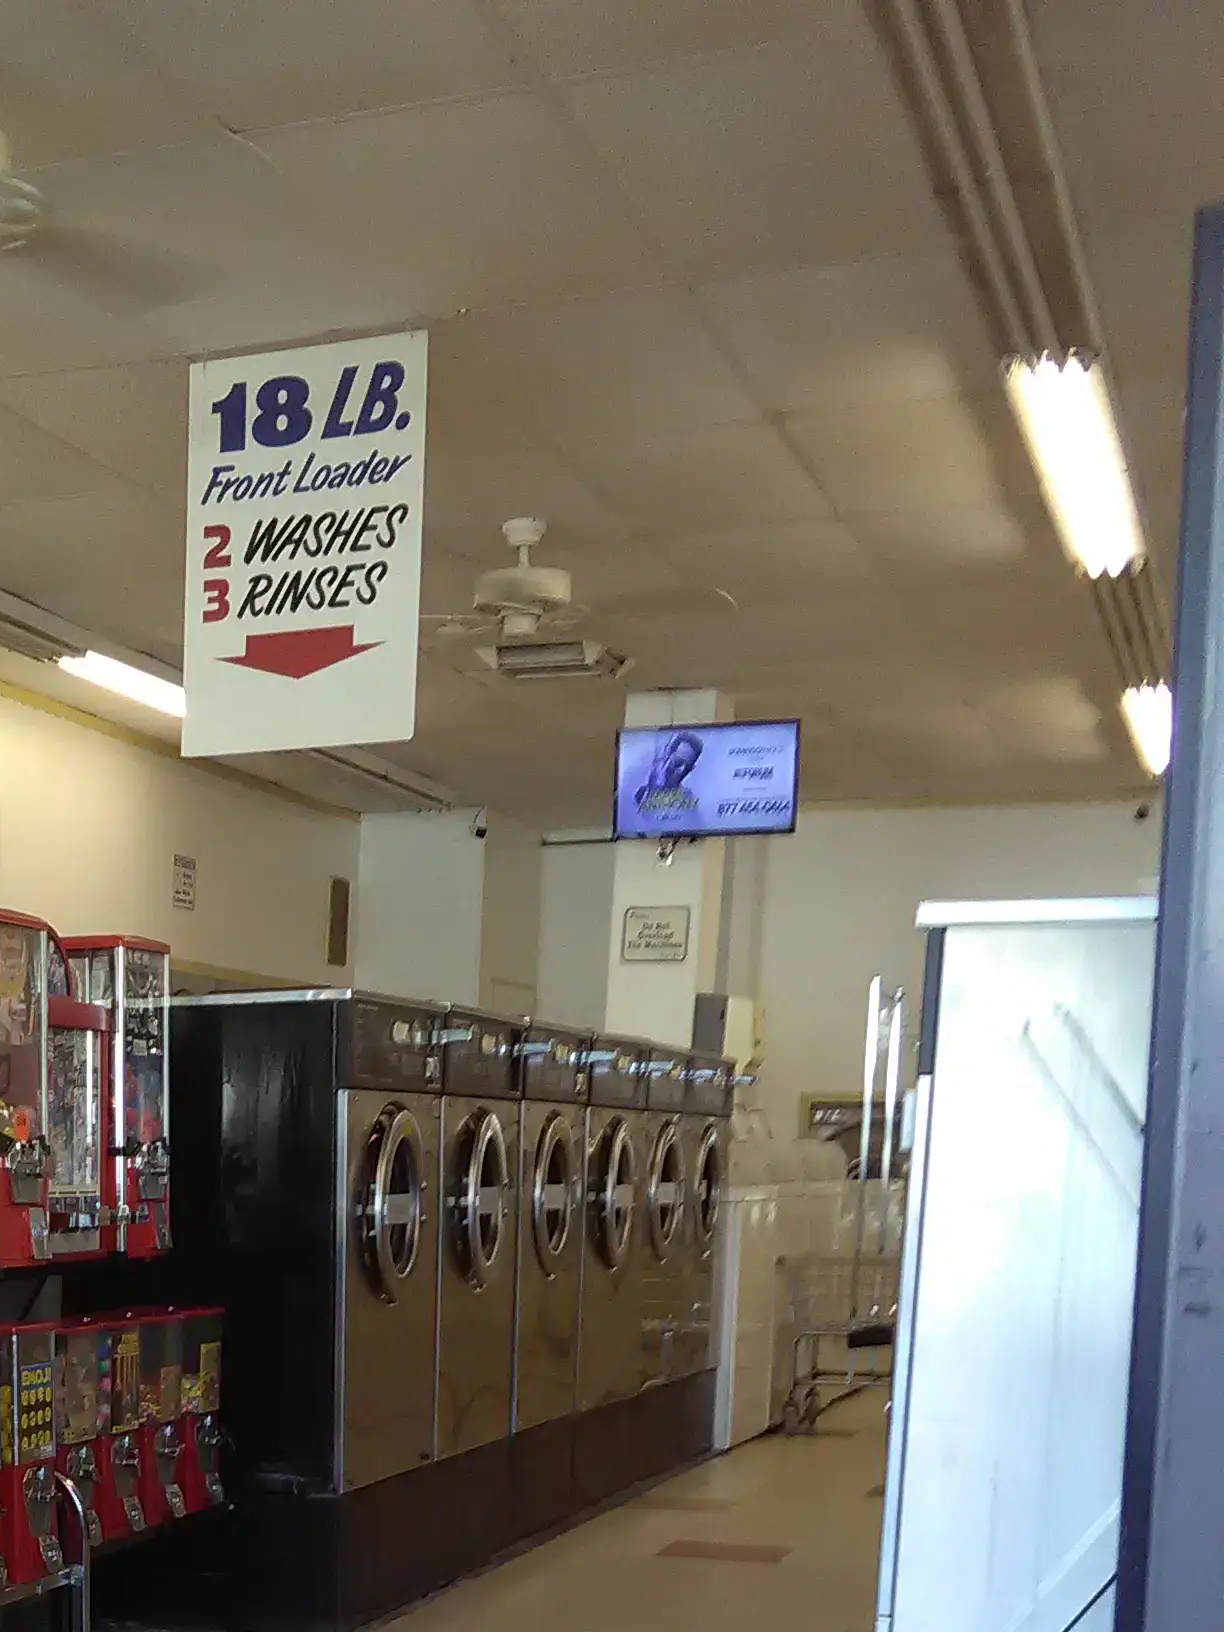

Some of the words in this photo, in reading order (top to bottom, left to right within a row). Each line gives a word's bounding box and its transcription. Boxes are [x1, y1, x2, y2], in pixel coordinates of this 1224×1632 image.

[211, 375, 313, 454] 18
[321, 359, 412, 440] LB.
[201, 454, 293, 506] Front
[293, 449, 413, 495] Loader
[202, 523, 232, 570] 2
[243, 503, 409, 567] WASHES
[202, 577, 231, 624] 3
[237, 559, 389, 620] RINSES
[22, 1367, 52, 1386] EMOJI
